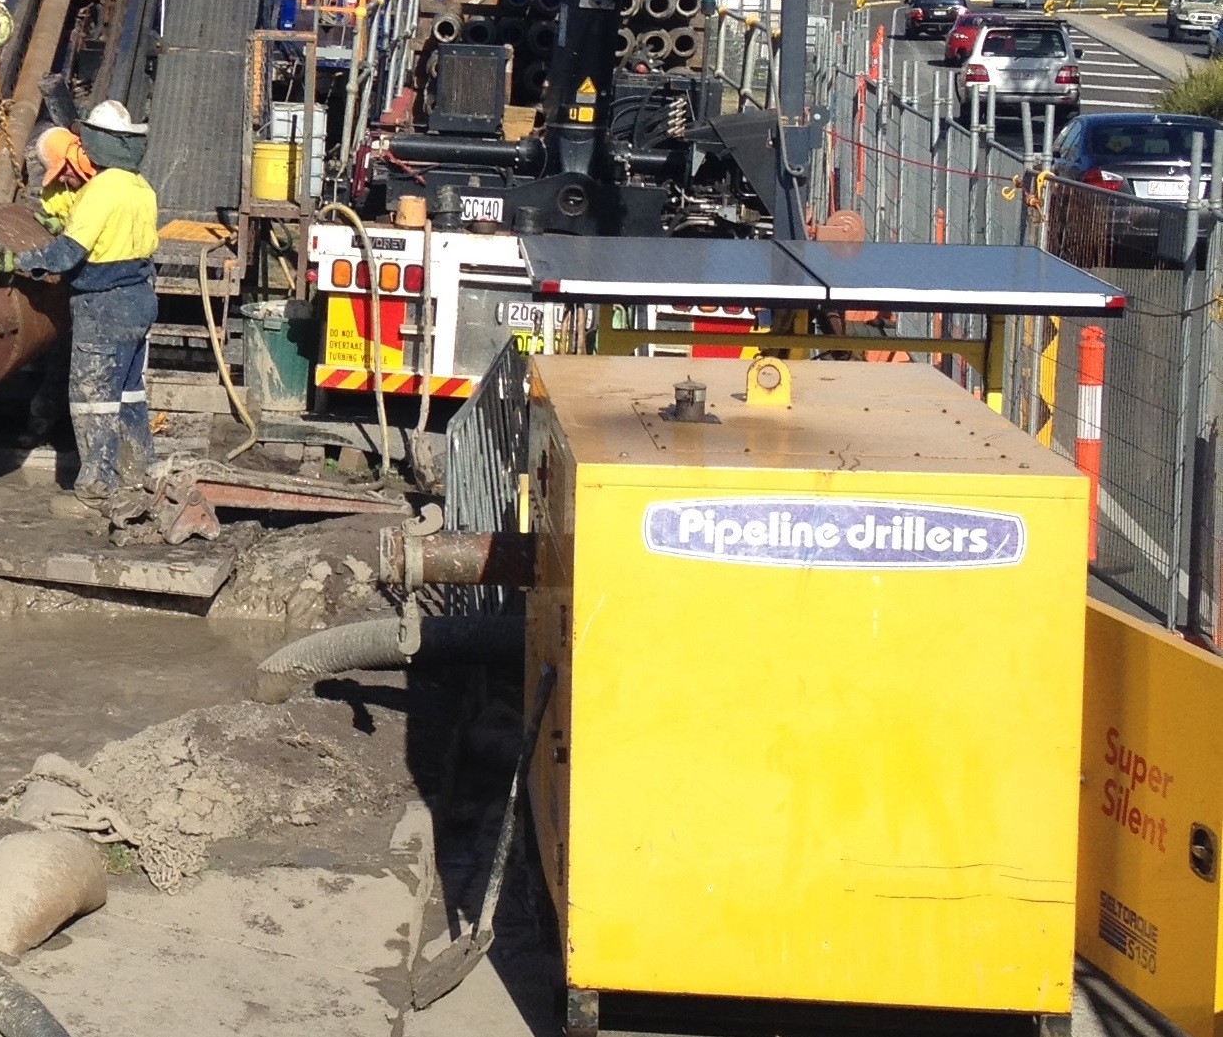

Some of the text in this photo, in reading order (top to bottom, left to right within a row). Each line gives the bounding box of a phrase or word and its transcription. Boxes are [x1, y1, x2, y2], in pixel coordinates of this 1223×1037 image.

[462, 199, 500, 220] CC140
[352, 235, 405, 250] VDREY
[679, 508, 988, 554] Pipeline drillers
[1104, 727, 1174, 800] Super
[1101, 778, 1168, 854] Silent
